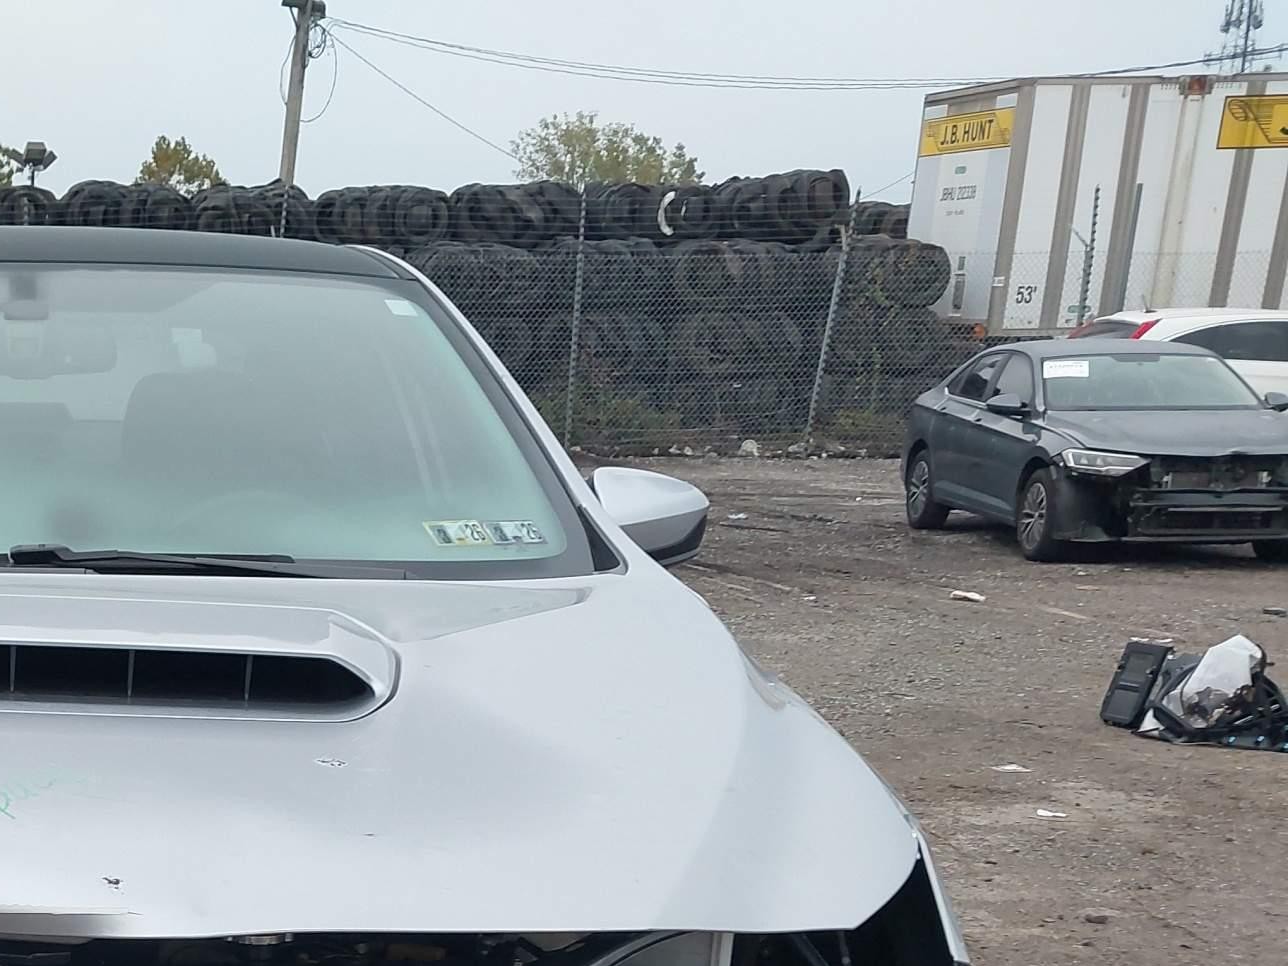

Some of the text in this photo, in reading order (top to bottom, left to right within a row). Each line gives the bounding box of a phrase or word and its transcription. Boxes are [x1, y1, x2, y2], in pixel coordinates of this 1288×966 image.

[940, 119, 994, 146] J.B. HUNT
[1015, 285, 1038, 304] 53'
